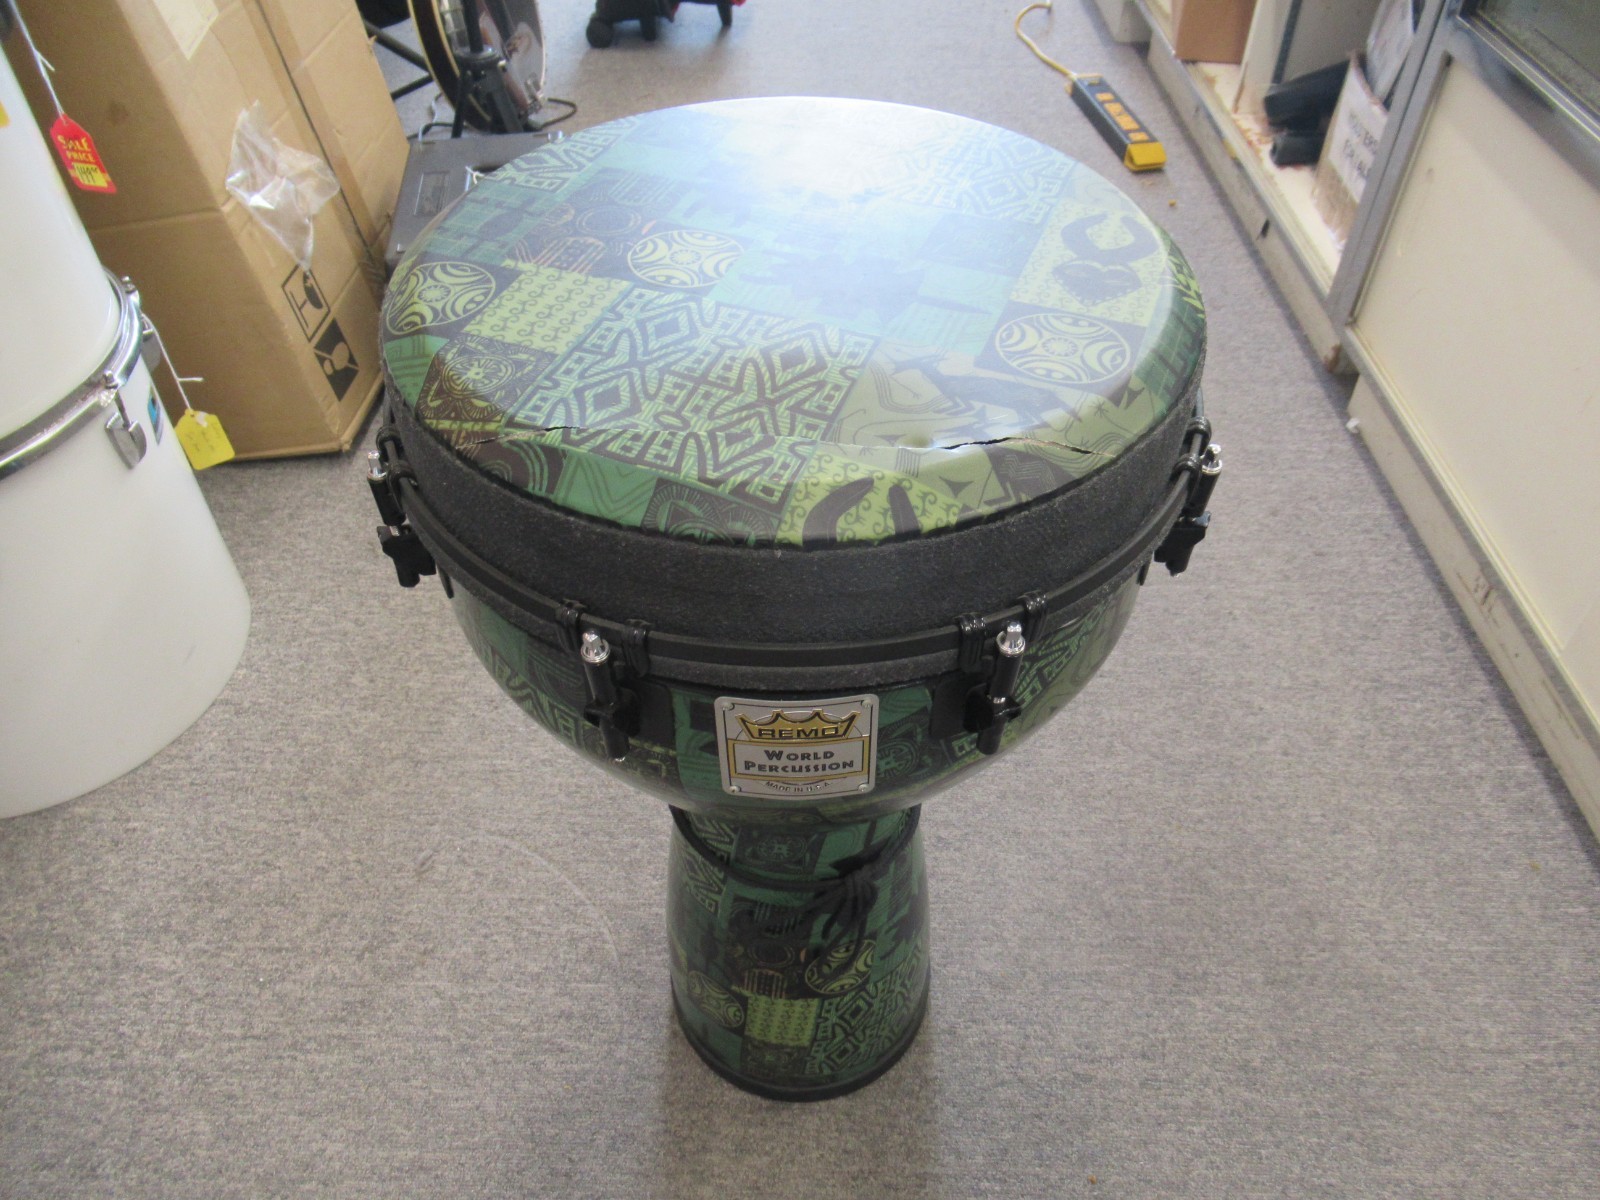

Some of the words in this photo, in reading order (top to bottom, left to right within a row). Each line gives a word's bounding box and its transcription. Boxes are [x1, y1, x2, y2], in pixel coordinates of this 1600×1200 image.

[57, 135, 91, 151] SALE
[66, 151, 96, 162] PRICE
[758, 727, 839, 738] REMO
[764, 750, 835, 761] WORLD
[744, 760, 854, 773] PERCUSSION
[765, 781, 791, 792] MADE
